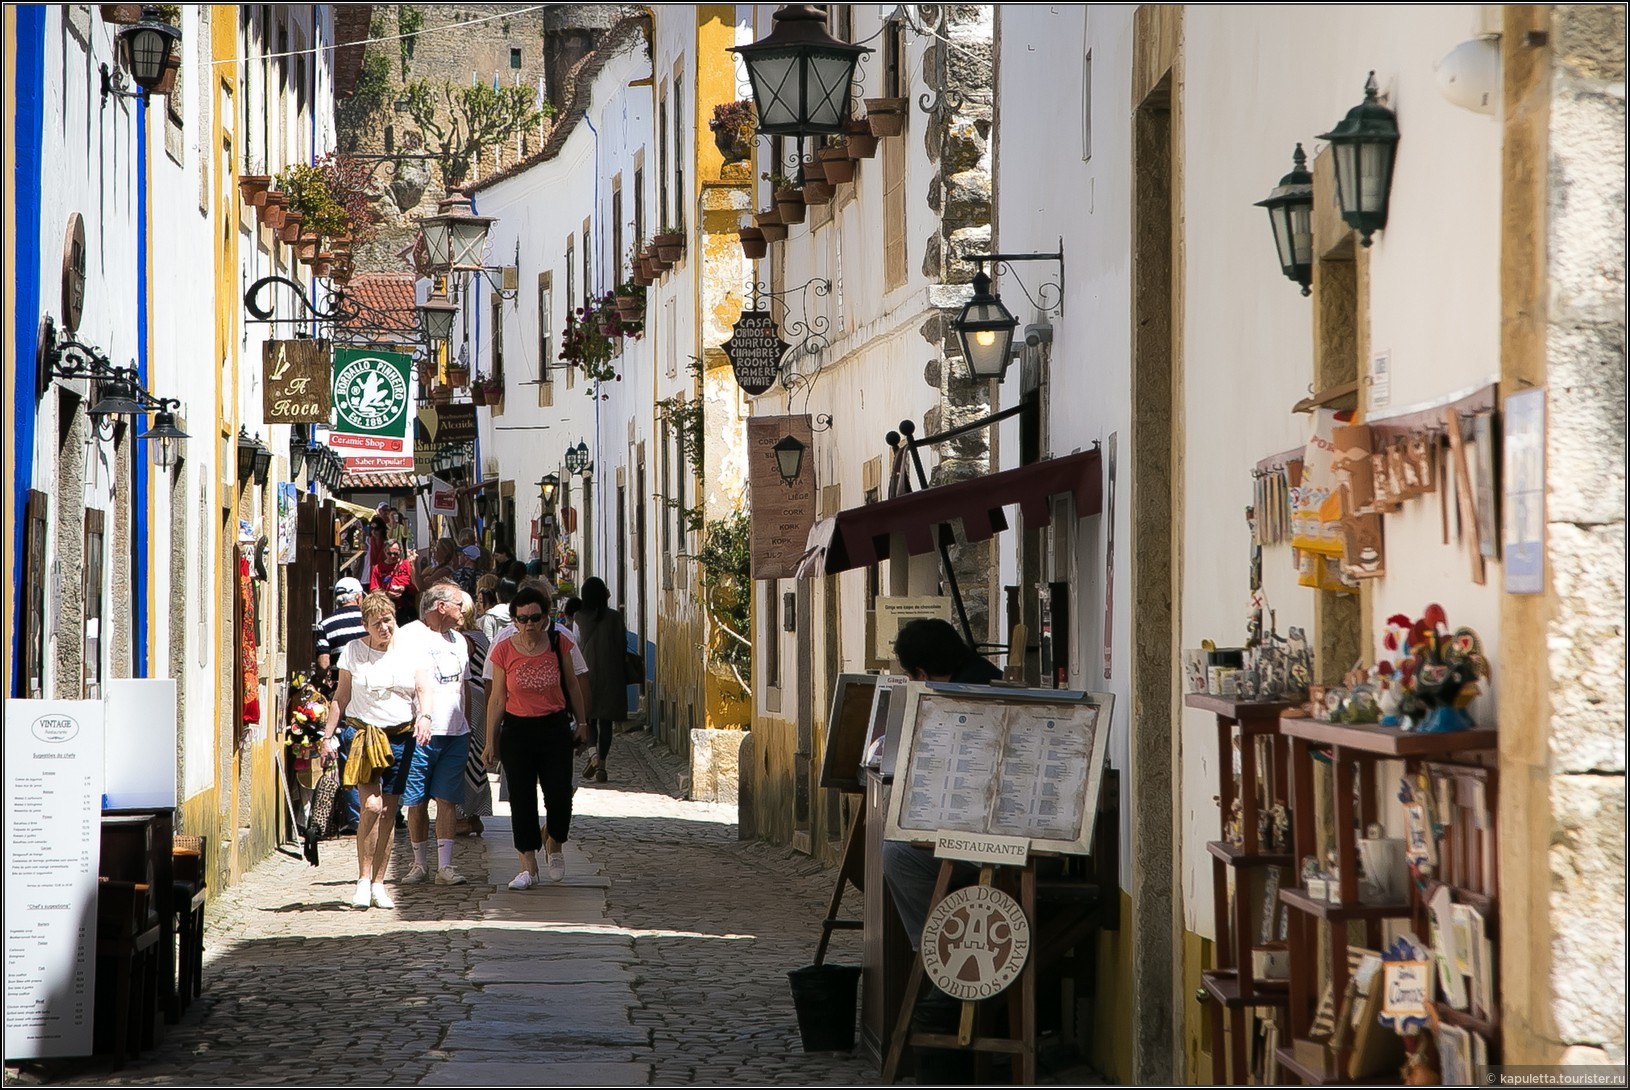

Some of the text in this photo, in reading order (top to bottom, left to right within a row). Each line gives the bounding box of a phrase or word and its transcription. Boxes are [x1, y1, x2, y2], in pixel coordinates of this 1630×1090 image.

[740, 318, 772, 328] CASA
[731, 338, 779, 348] QUARTOS
[731, 347, 780, 358] CHAMBRES
[737, 358, 775, 367] ROOMS
[736, 367, 777, 377] CAMERE
[337, 360, 404, 400] BORDALLO PINHEIRO
[739, 376, 770, 386] PRIVATE
[271, 400, 320, 416] Roca
[348, 412, 389, 427] Est. 1884
[331, 436, 385, 449] Ceramic Shop
[355, 457, 406, 467] Saber Popular!
[779, 523, 800, 531] KORK
[40, 719, 72, 728] VINTAGE
[938, 838, 1025, 856] RESTAURANTE
[924, 887, 1027, 973] PETRARUM DOMUS BAR
[938, 975, 1002, 999] OBIDOS
